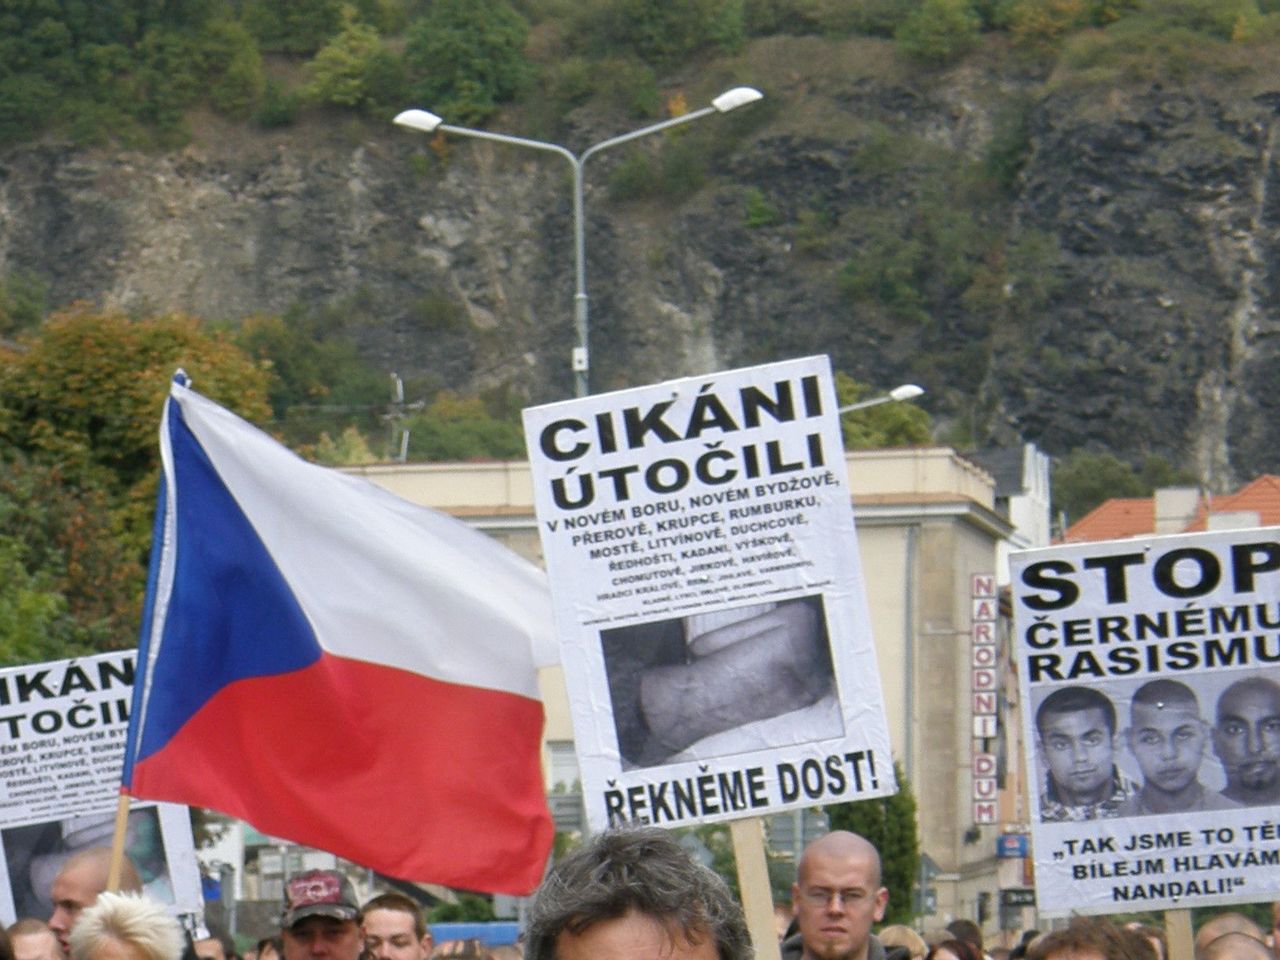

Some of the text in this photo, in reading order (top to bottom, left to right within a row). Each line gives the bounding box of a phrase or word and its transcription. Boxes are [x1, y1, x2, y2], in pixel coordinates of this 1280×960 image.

[539, 374, 824, 463] CIKÁNI
[550, 432, 826, 512] ÚTOČILI
[546, 471, 841, 533] V NOVÉM BORU, NOVÉM BYDŽOVĚ,
[571, 494, 821, 547] PŘEROVĚ, KRUPCE, RUMBURKU,
[589, 513, 809, 560] MOSTĚ, LITVÍNOVĚ, DUCHCOVĚ,
[1021, 541, 1280, 612] STOP
[1025, 601, 1280, 651] ČERNÉMU
[1028, 634, 1280, 684] RASISMU
[603, 749, 880, 829] ŘEKNĚME DOST!
[1124, 831, 1192, 851] JSME
[1200, 827, 1234, 845] TO
[1242, 820, 1280, 842] TĚ
[1073, 847, 1280, 880] BÍLEJM HLAVÁM
